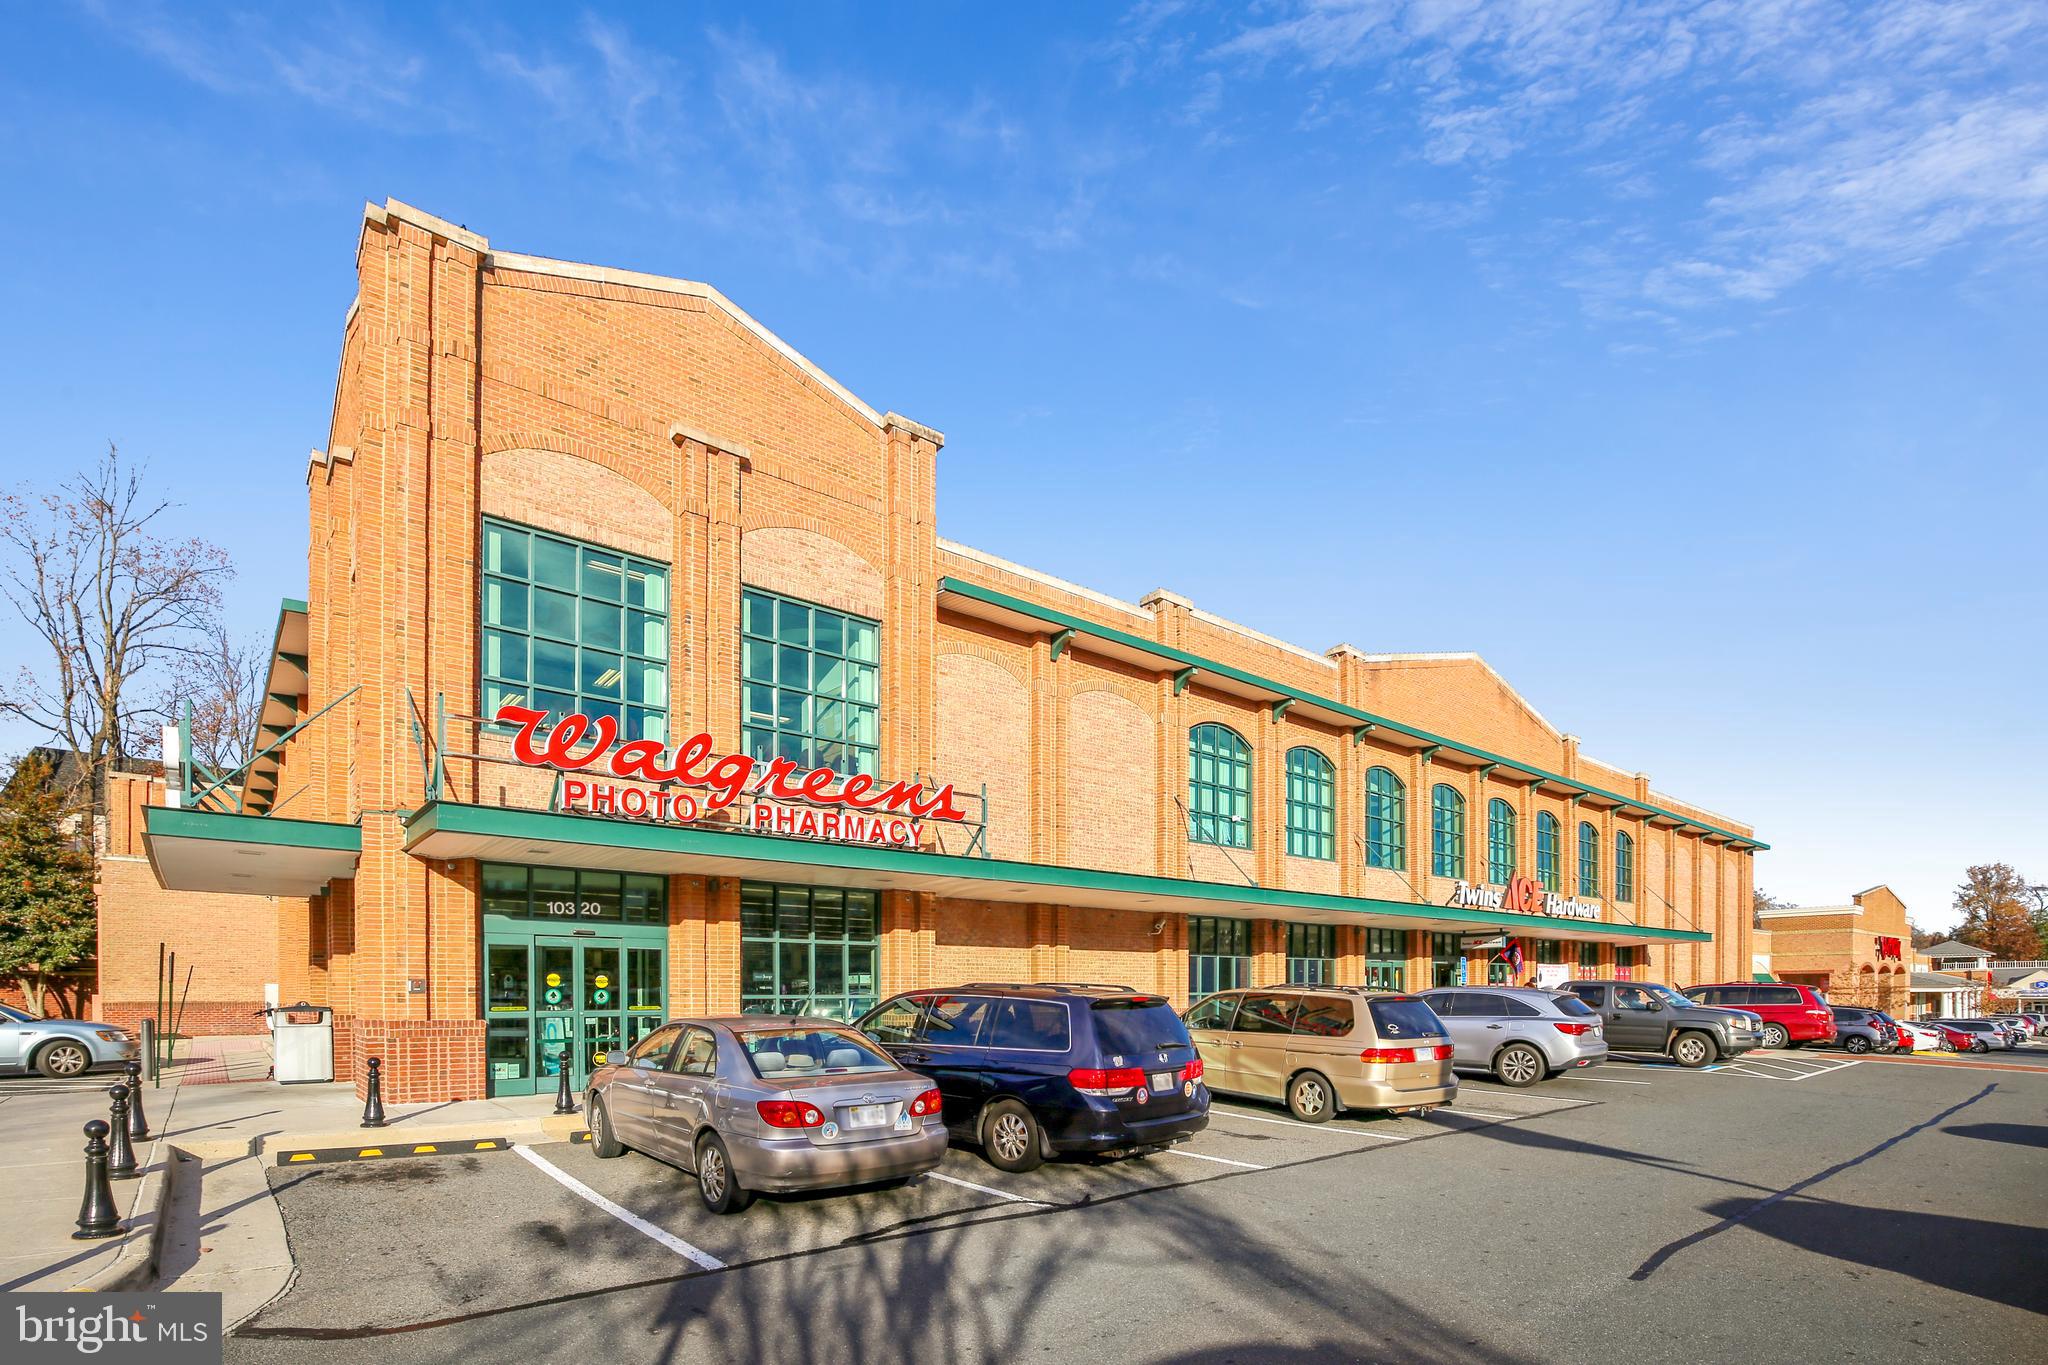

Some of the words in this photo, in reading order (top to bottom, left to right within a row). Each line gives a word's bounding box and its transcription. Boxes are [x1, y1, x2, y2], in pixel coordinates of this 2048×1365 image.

[493, 705, 967, 821] Walgreens
[562, 780, 698, 823] PHOTO
[750, 803, 925, 848] PHARMACY
[1457, 880, 1502, 909] Twins
[1502, 868, 1545, 913] ACE
[1545, 892, 1601, 919] Hardware
